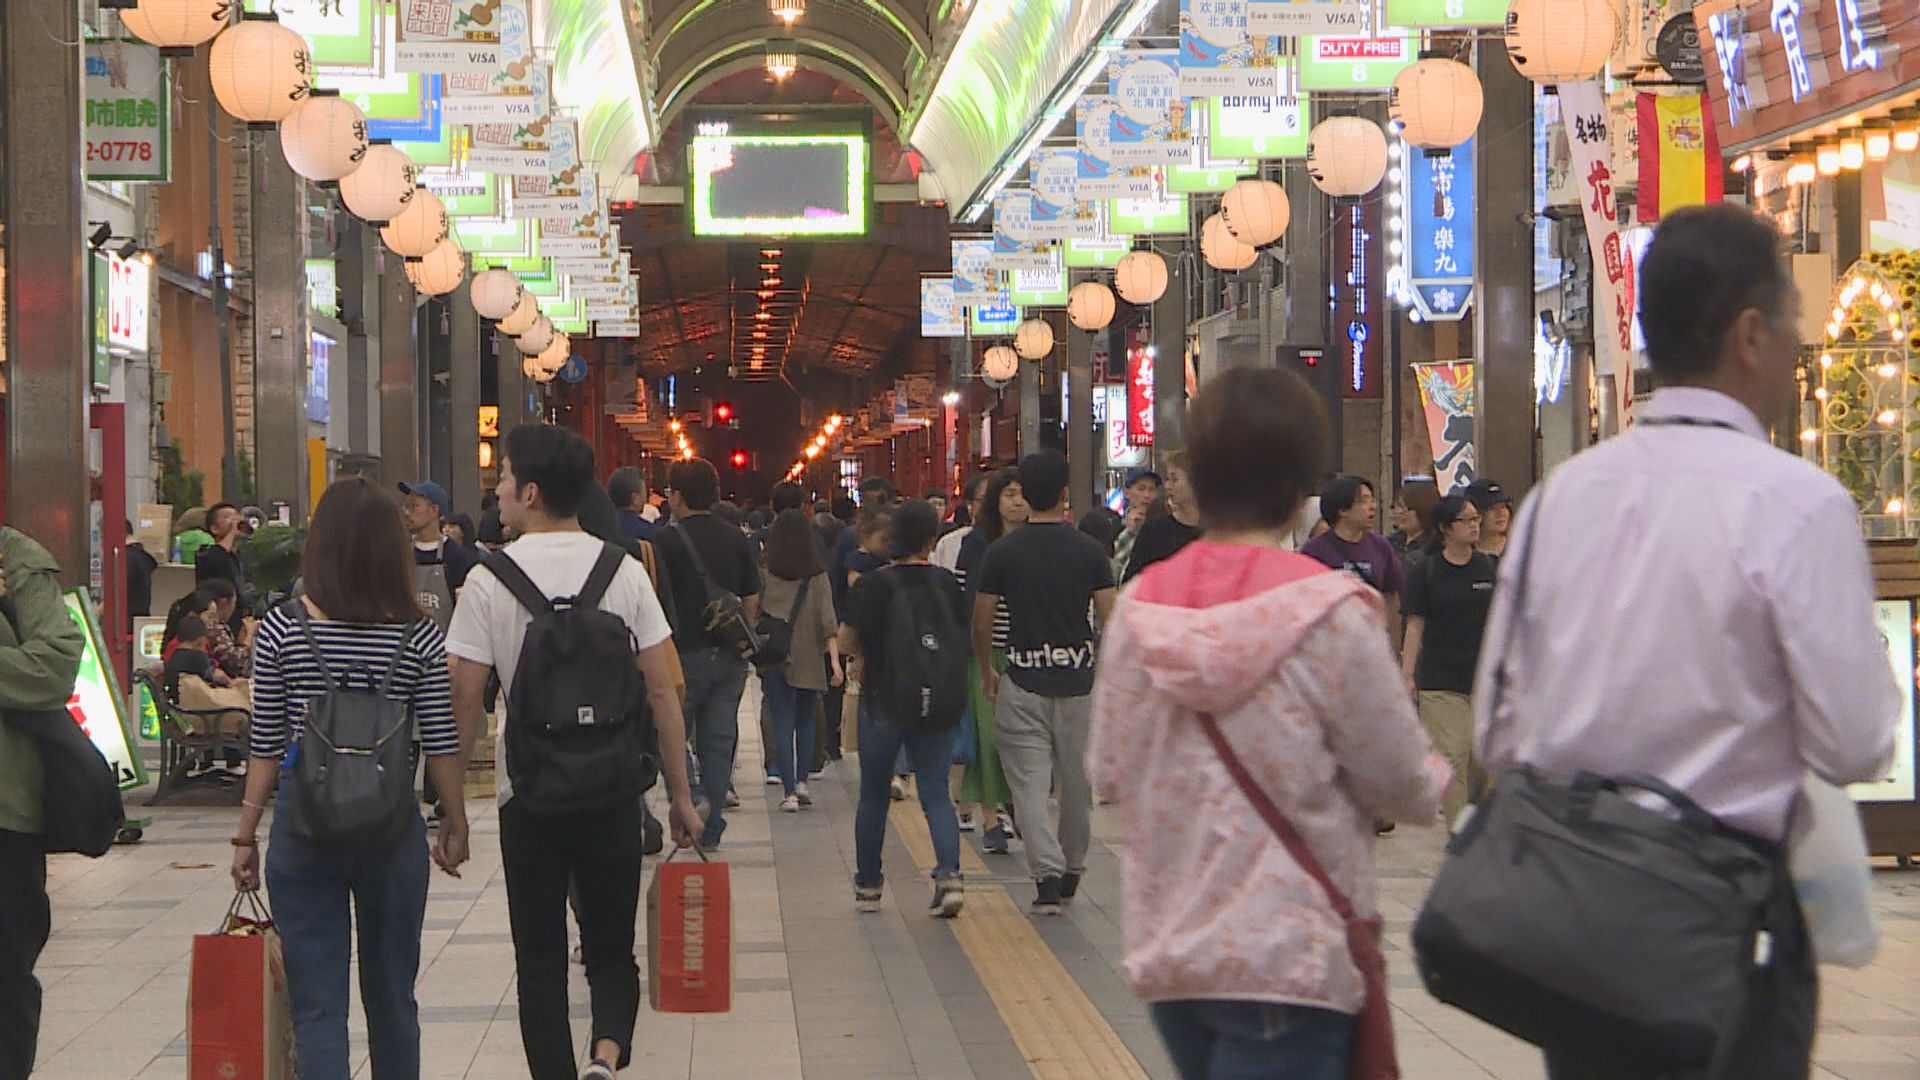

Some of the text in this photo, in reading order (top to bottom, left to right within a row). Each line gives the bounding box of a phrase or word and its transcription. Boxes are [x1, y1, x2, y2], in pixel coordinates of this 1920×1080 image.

[1199, 1, 1248, 14] 欢迎来
[1325, 13, 1356, 25] VISA
[1320, 41, 1400, 55] DUTY FREE
[468, 52, 497, 63] VISA
[1352, 64, 1368, 82] 6
[1247, 76, 1274, 87] VISA
[504, 104, 531, 113] VISA
[1575, 113, 1607, 144] 名物
[1167, 149, 1189, 157] VISA
[524, 158, 546, 167] VISA
[1129, 183, 1149, 191] VISA
[560, 203, 579, 211] VISA
[1076, 224, 1094, 232] VISA
[1112, 419, 1127, 459] ワイン
